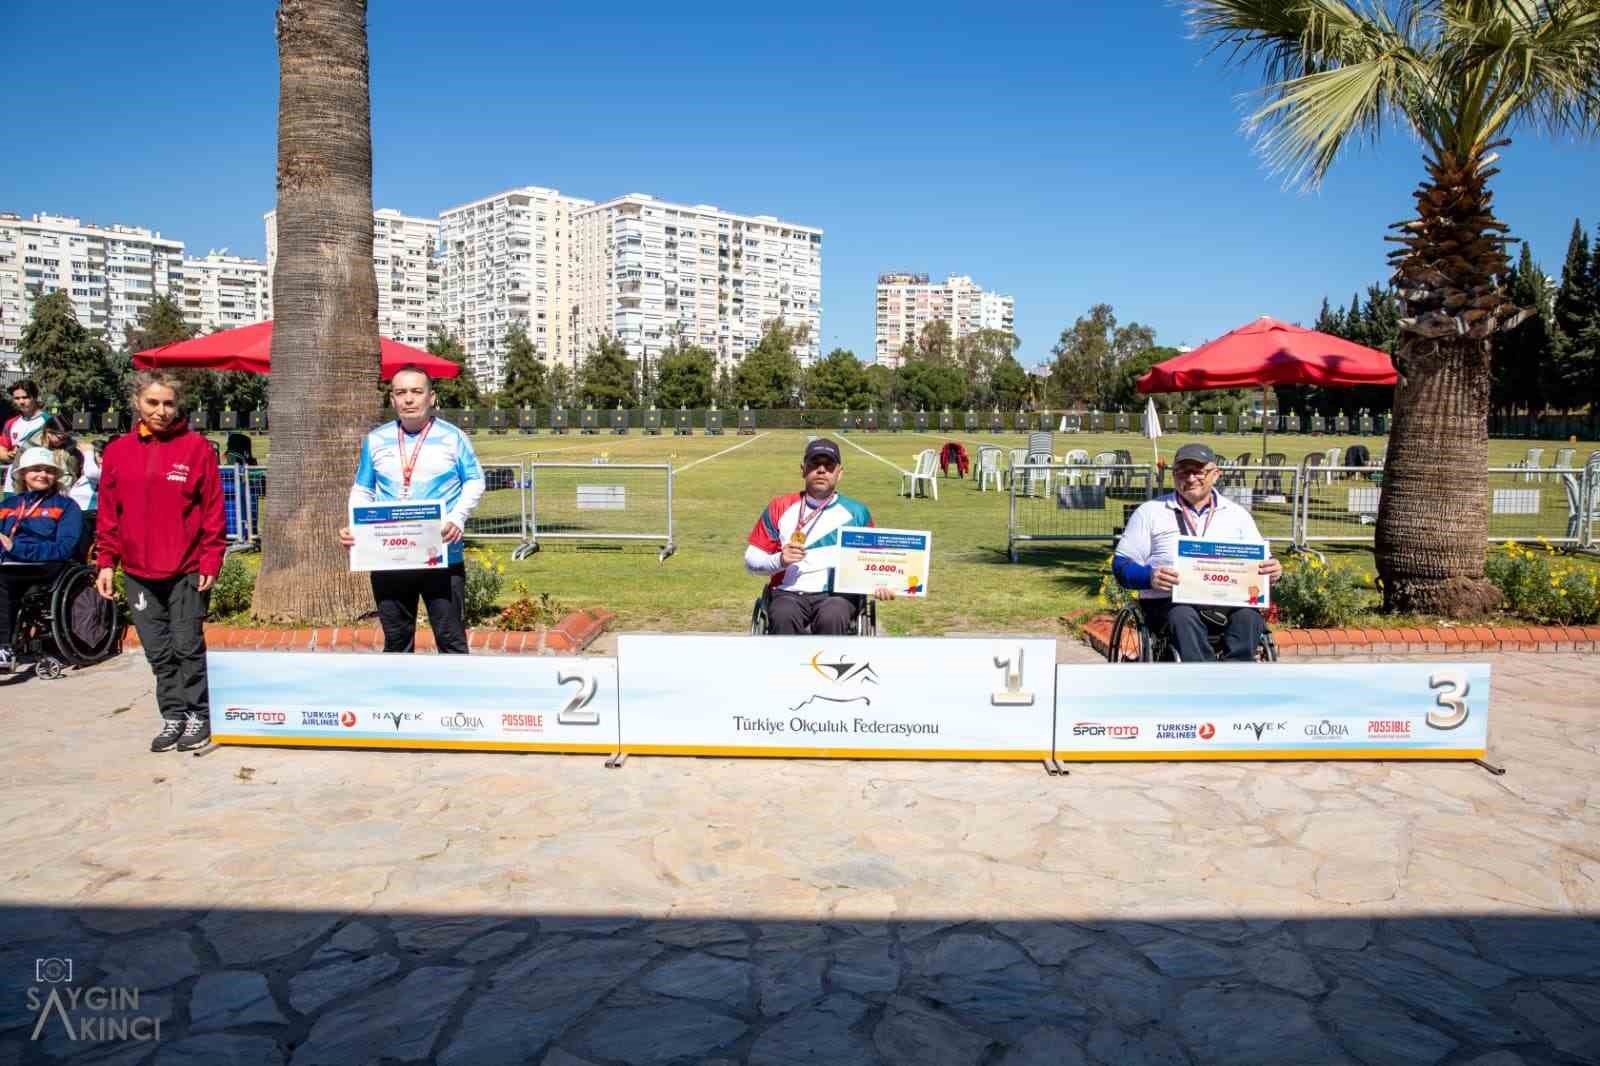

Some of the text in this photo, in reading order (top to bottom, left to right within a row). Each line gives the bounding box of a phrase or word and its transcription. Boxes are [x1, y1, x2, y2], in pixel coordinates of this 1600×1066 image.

[382, 538, 408, 546] 7.000
[863, 564, 896, 573] 10.000
[1202, 574, 1230, 582] 5.000
[991, 648, 1035, 706] 1
[557, 670, 601, 726] 2
[1425, 673, 1471, 731] 3
[302, 711, 339, 719] TURKISH
[302, 718, 340, 727] AIRLINES
[372, 711, 424, 731] NAVEK
[440, 712, 485, 729] GLORIA
[501, 713, 543, 728] POSSIBLE
[733, 716, 940, 737] Türkiye Okçuluk Federasyonu
[1156, 723, 1198, 731] TURKISH
[1233, 721, 1288, 741] NAVEK
[1304, 719, 1350, 736] GLORIA
[1367, 720, 1412, 733] POSSIBLE
[1156, 731, 1197, 740] AIRLINES
